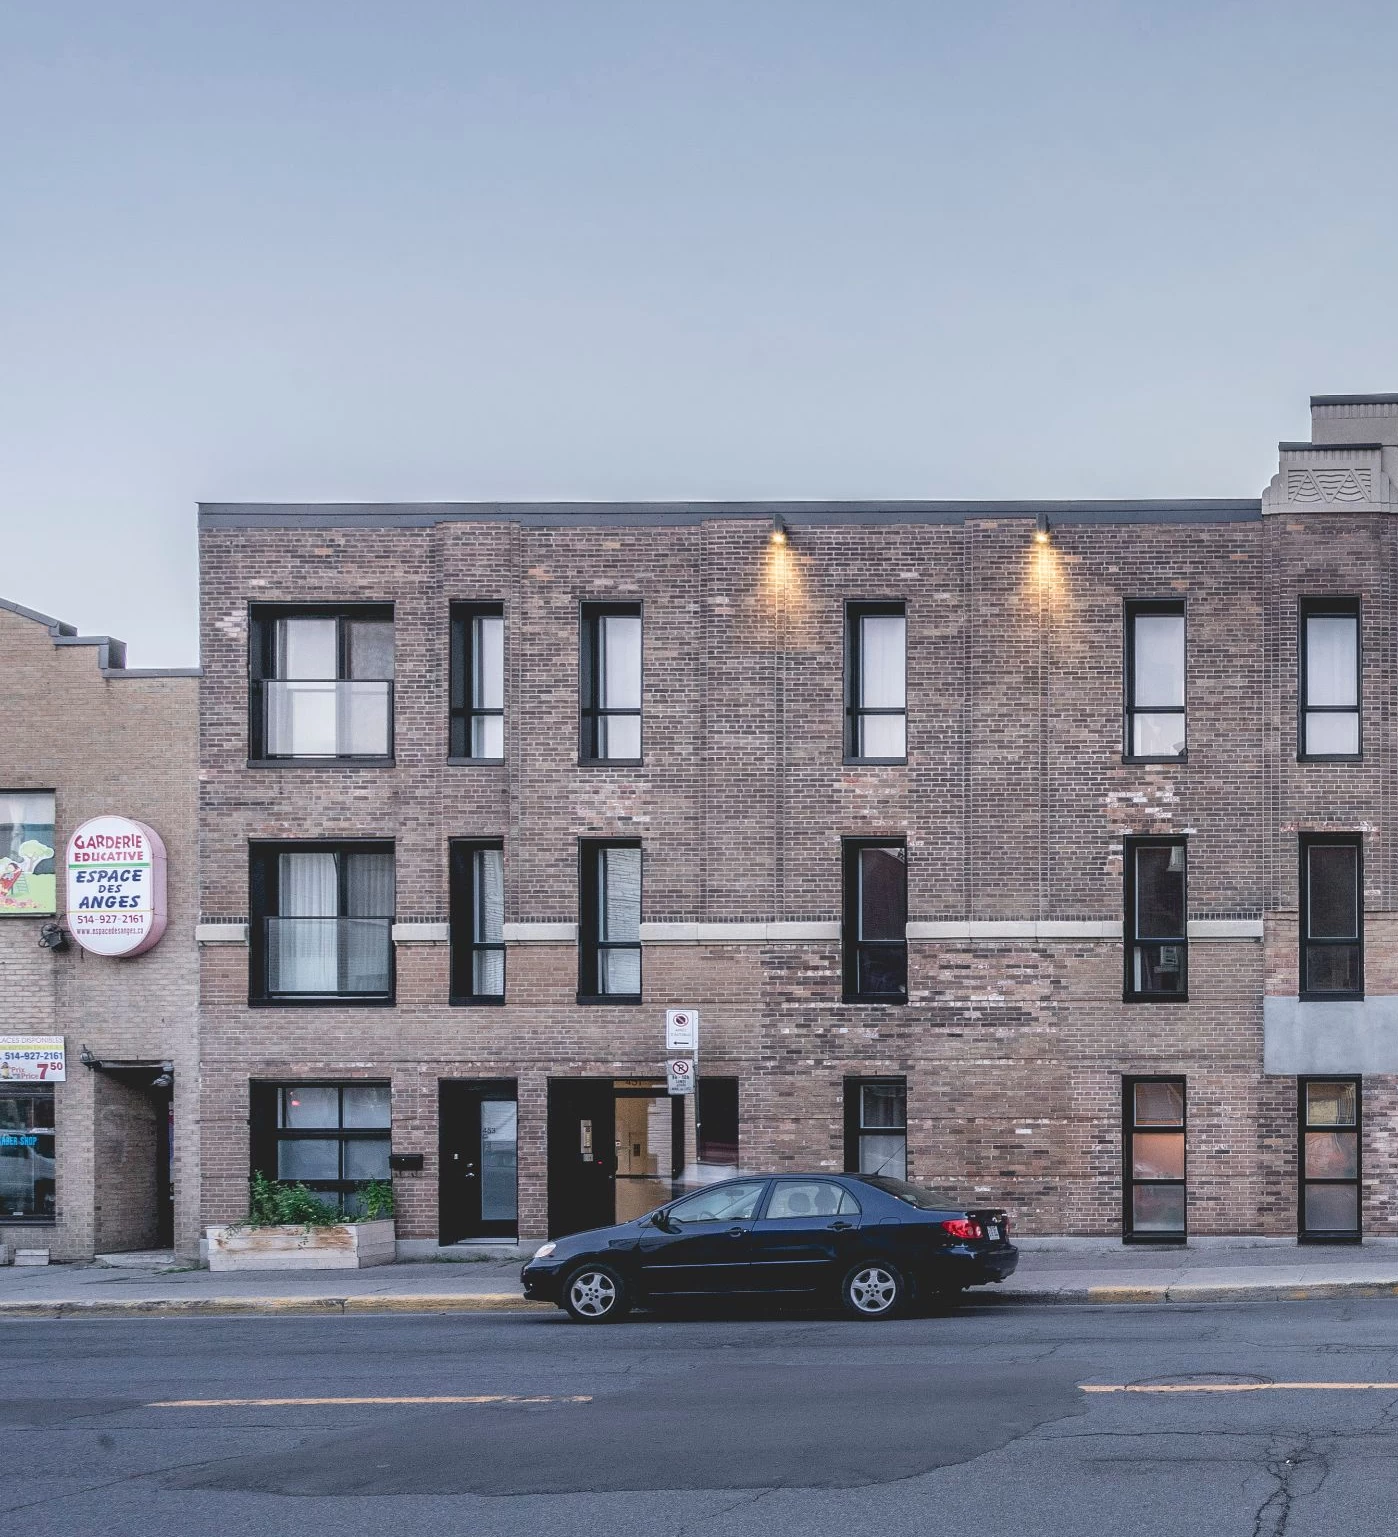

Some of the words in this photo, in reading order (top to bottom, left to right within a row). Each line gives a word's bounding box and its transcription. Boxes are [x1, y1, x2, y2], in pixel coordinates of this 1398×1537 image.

[74, 834, 142, 849] GARDERIE
[74, 851, 143, 862] EDUCATIVE
[76, 869, 142, 883] ESPACE
[98, 884, 122, 893] DES
[79, 895, 140, 909] ANGES
[77, 914, 143, 924] 514-927-2161
[5, 1052, 63, 1060] 514-927-2161
[37, 1063, 49, 1080] 7
[50, 1062, 63, 1071] 50
[20, 1137, 37, 1146] SHOP
